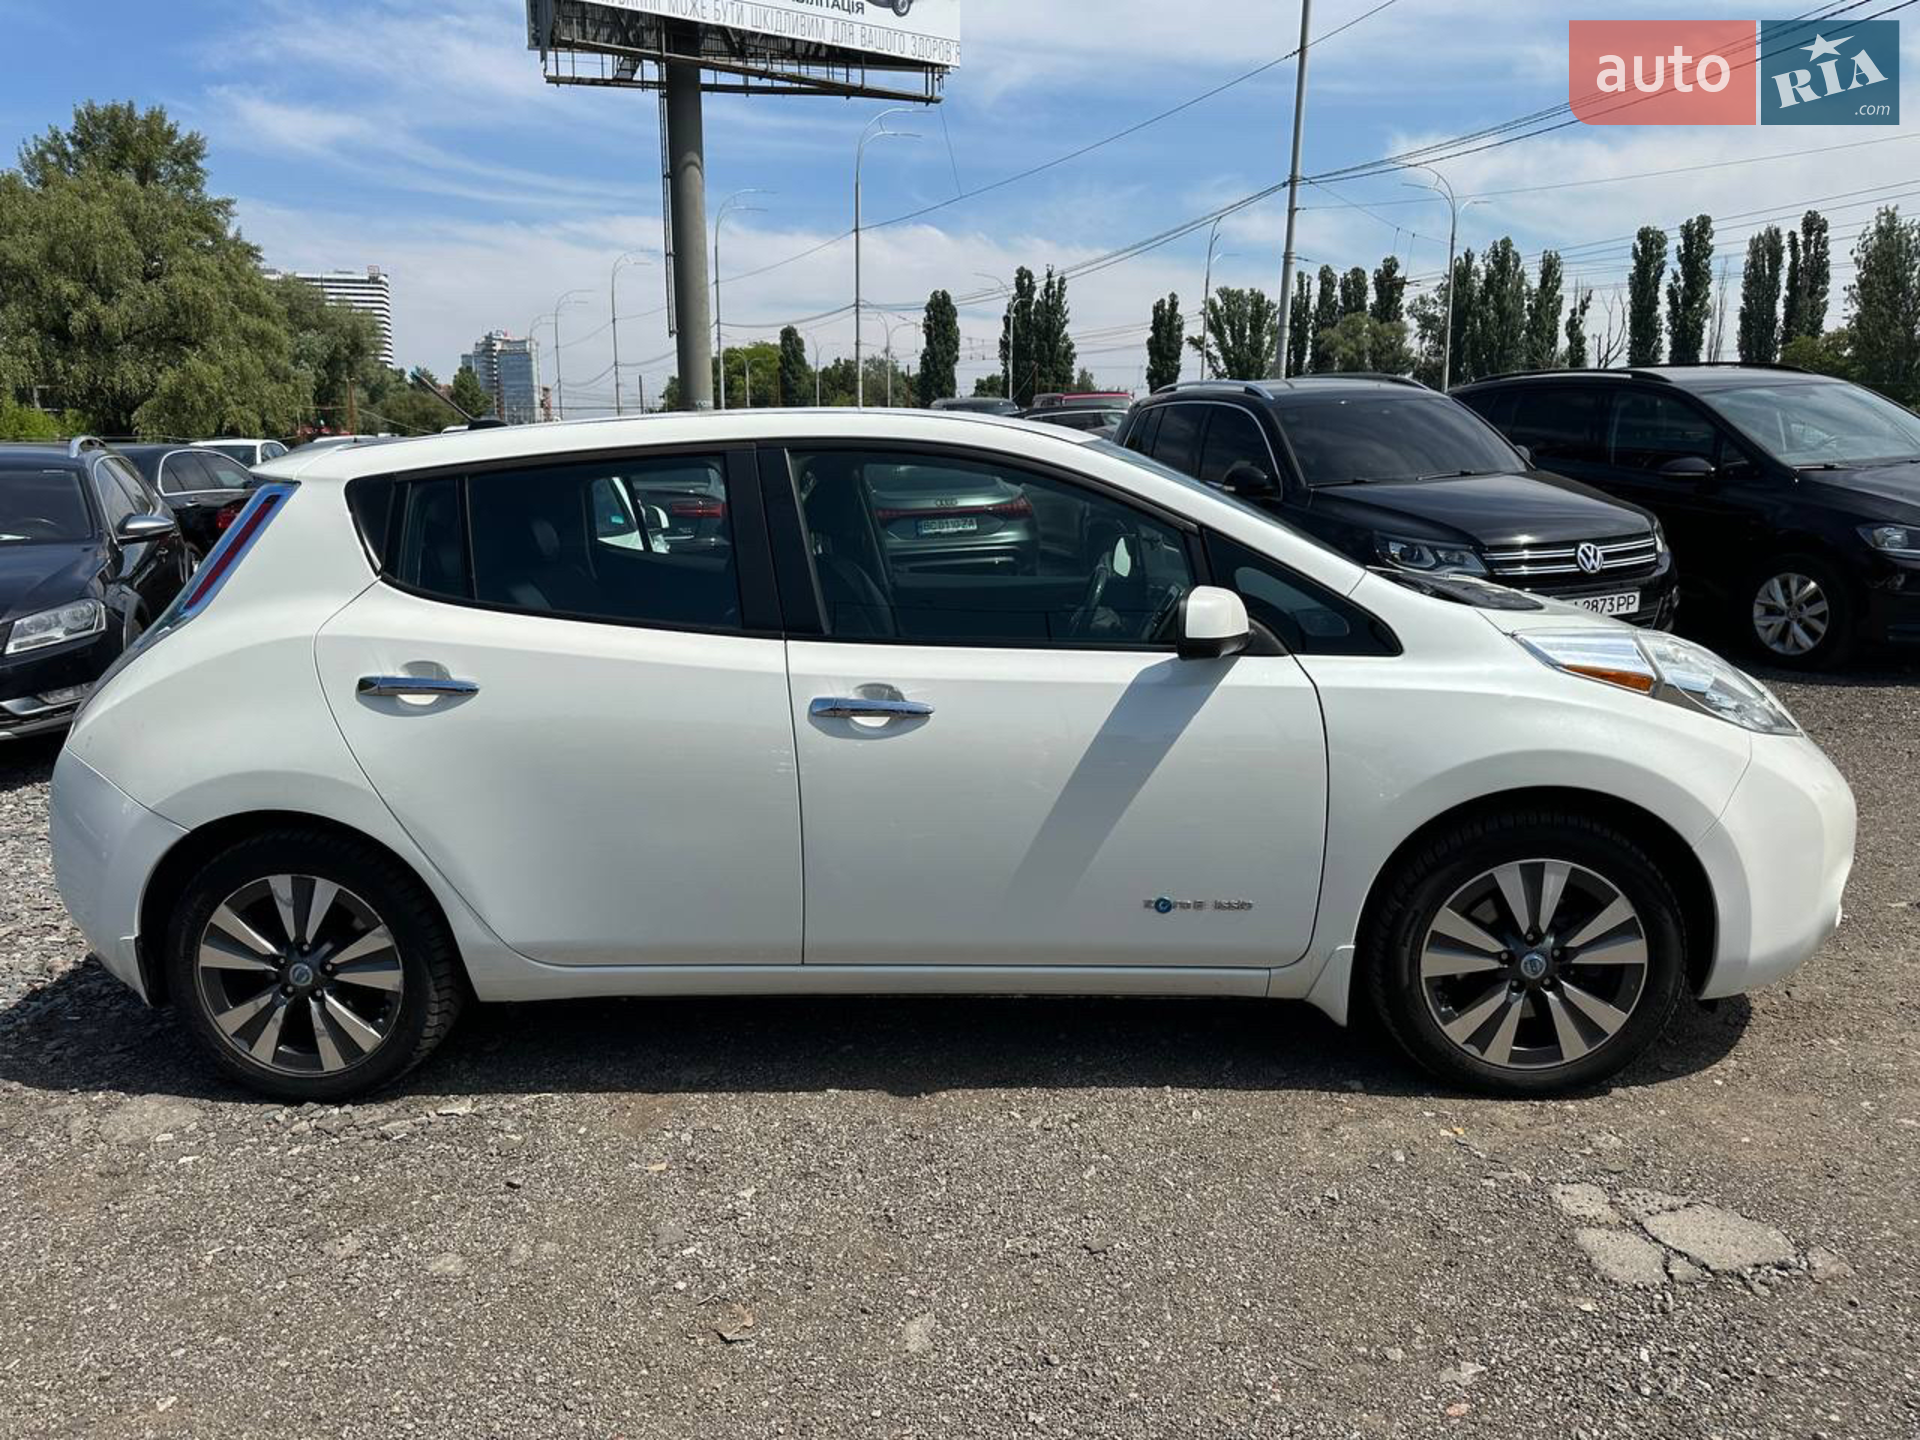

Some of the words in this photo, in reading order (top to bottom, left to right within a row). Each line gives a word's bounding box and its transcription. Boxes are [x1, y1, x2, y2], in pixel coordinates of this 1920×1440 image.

[668, 0, 708, 20] МОЖЕ
[714, 0, 746, 26] БУТИ
[750, 6, 826, 40] ШКІДЛИВИМ
[830, 20, 855, 45] ДЛЯ
[860, 26, 905, 54] ВАШОГО
